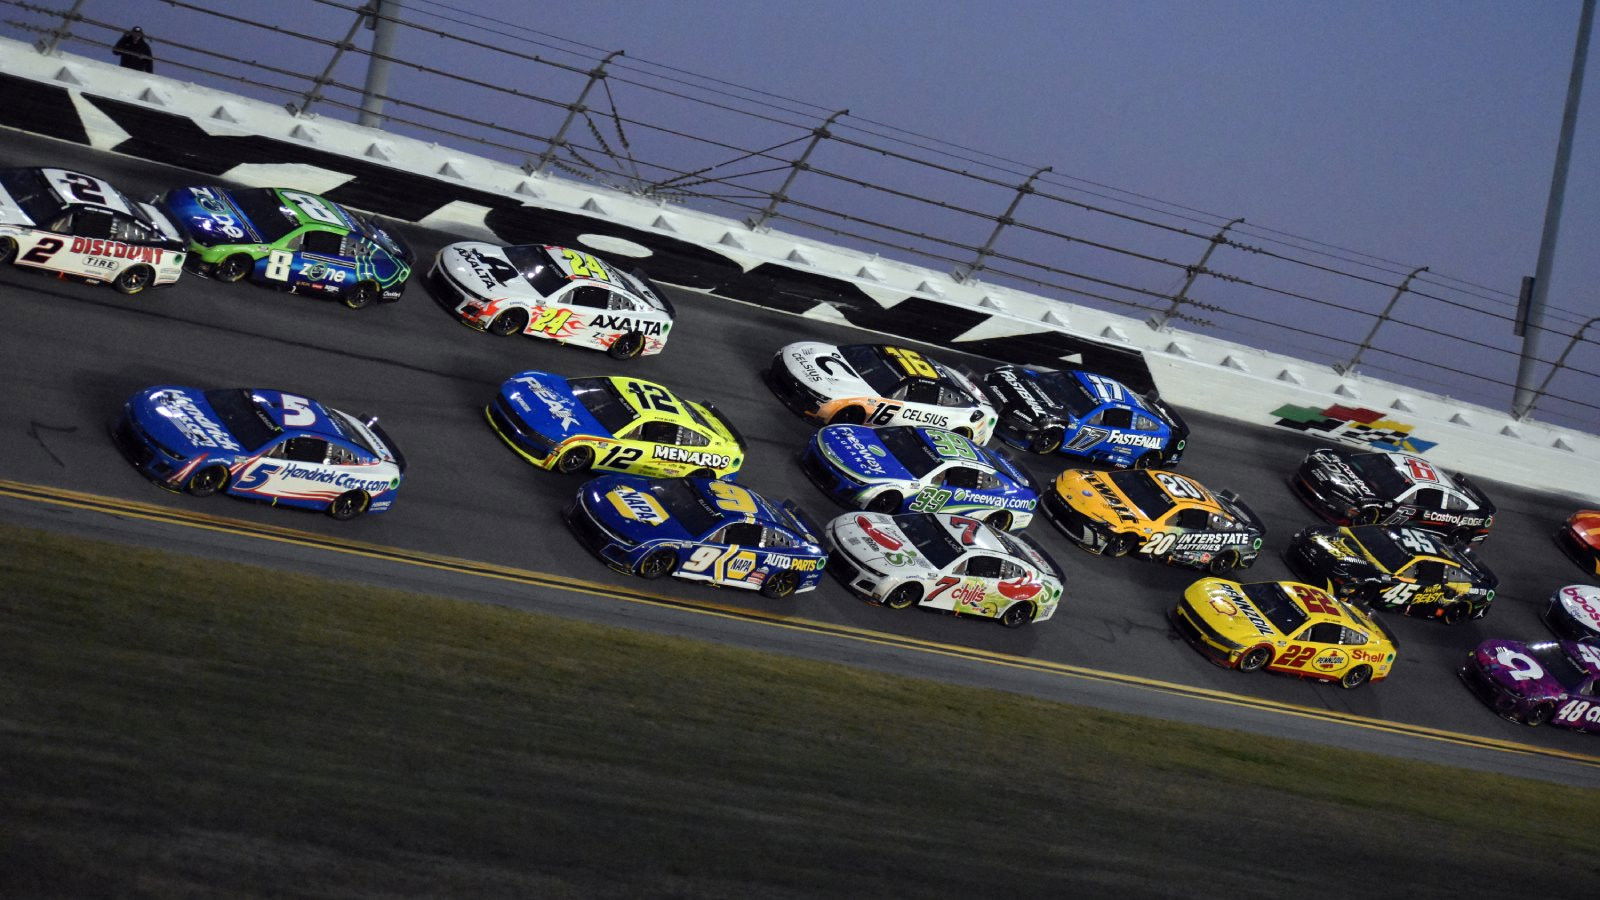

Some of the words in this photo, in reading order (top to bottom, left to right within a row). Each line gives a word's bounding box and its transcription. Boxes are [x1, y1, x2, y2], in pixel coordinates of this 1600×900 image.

[58, 172, 107, 205] 2
[21, 237, 64, 264] 2
[70, 236, 164, 265] DISCOUNT
[86, 256, 116, 270] TIRE
[265, 249, 293, 282] 8
[453, 246, 497, 290] AXALTA
[562, 247, 612, 283] 24
[529, 307, 574, 335] 24
[588, 313, 661, 337] AXALTA
[791, 351, 824, 383] CELSIUS
[884, 346, 939, 380] 16
[627, 381, 680, 415] 12
[1085, 373, 1125, 402] 17
[281, 394, 316, 427] 5
[866, 402, 902, 427] 16
[901, 407, 949, 428] CELSIUS
[924, 428, 979, 461] 99
[1064, 423, 1112, 452] 17
[1106, 429, 1163, 450] FASTENAL
[596, 444, 645, 471] 12
[652, 444, 731, 470] MENARDS
[235, 463, 281, 491] 5
[280, 462, 390, 492] HendrickCars.com
[1155, 472, 1207, 502] 20
[708, 481, 759, 514] 9
[909, 486, 952, 515] 99
[963, 491, 1030, 510] Freeway.com
[950, 516, 981, 547] 7
[1430, 510, 1462, 526] Castrol
[1138, 532, 1178, 556] 20
[1175, 543, 1222, 552] BATTERIES
[1177, 533, 1250, 546] INTERSTATE
[682, 547, 722, 574] 9
[729, 558, 754, 573] NAPA
[763, 554, 793, 570] AUTO
[790, 559, 818, 572] PARTS
[923, 576, 962, 603] 7
[1292, 585, 1342, 616] 22
[1381, 582, 1421, 605] 45
[1273, 644, 1317, 667] 22
[1351, 649, 1385, 663] Shell
[1558, 700, 1590, 721] 48
